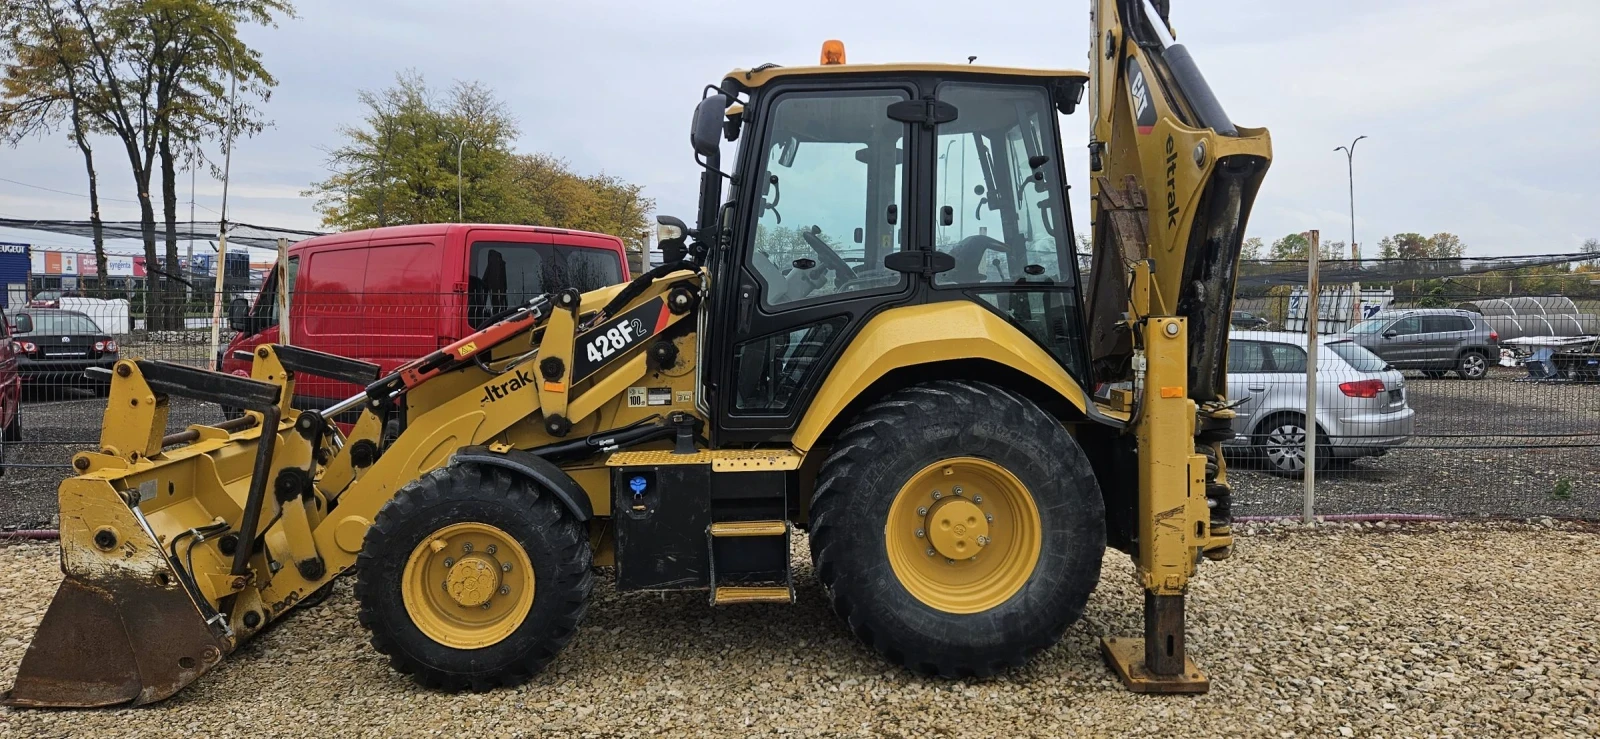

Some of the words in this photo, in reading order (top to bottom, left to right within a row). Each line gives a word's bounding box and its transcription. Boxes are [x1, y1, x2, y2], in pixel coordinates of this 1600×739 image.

[1131, 72, 1148, 120] CAT
[1165, 133, 1180, 230] eltrak
[109, 260, 131, 270] syngenta
[630, 395, 641, 405] 100
